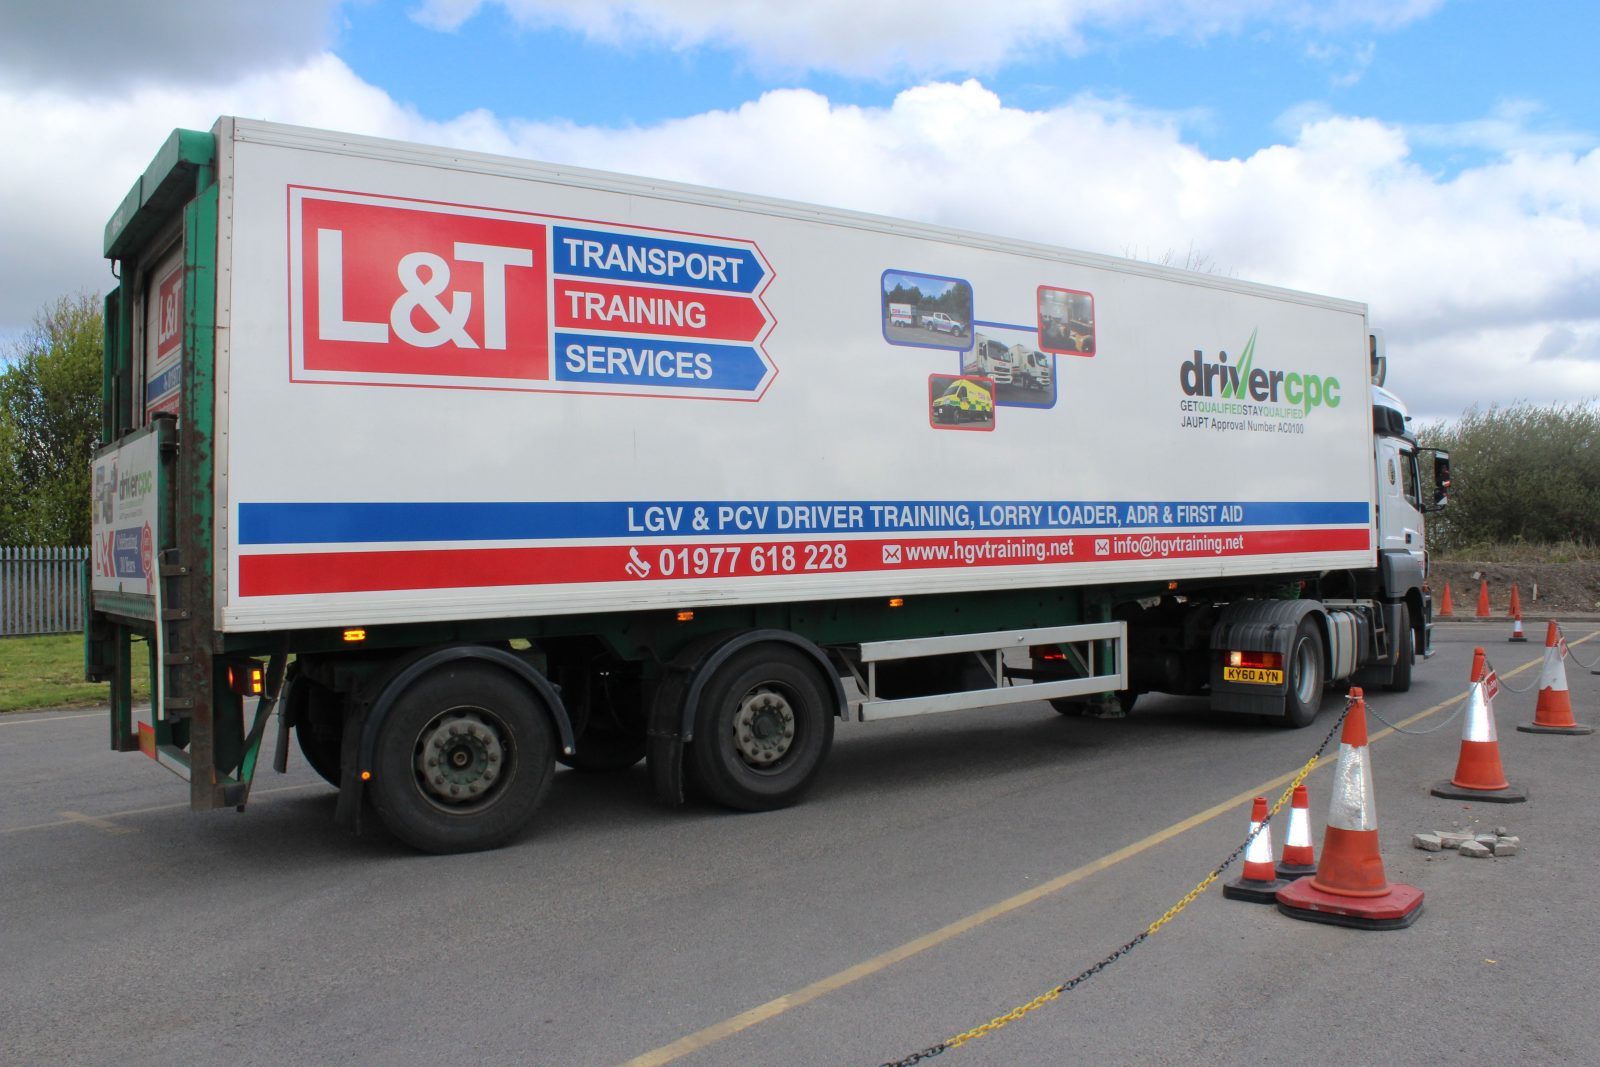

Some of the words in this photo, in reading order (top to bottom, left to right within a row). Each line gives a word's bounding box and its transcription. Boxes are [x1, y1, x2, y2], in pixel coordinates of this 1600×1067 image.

[562, 237, 744, 285] TRANSPORT
[317, 227, 534, 351] L&T
[159, 280, 182, 343] L&T
[564, 289, 707, 330] TRAINING
[565, 343, 713, 381] SERVICES
[1181, 415, 1209, 429] JAUPT
[1211, 418, 1246, 432] Approval
[1247, 420, 1277, 433] Number
[1277, 422, 1304, 434] AC0100
[628, 506, 684, 532] LGV
[691, 506, 711, 531] &
[718, 505, 770, 531] PCV
[776, 505, 864, 529] DRIVER
[869, 505, 975, 530] TRAINING,
[978, 505, 1044, 527] LORRY
[1048, 505, 1122, 527] LOADER,
[1125, 505, 1158, 525] ADR
[1162, 505, 1173, 524] &
[1176, 505, 1217, 524] FIRST
[1219, 505, 1244, 524] AID
[658, 547, 742, 577] 01977
[750, 544, 797, 573] 618
[803, 543, 848, 570] 228
[905, 538, 1075, 564] www.hgvtraining.net
[1113, 534, 1245, 558] info@hgvtraining.net
[1228, 669, 1256, 681] KY60
[1258, 671, 1279, 682] AYN
